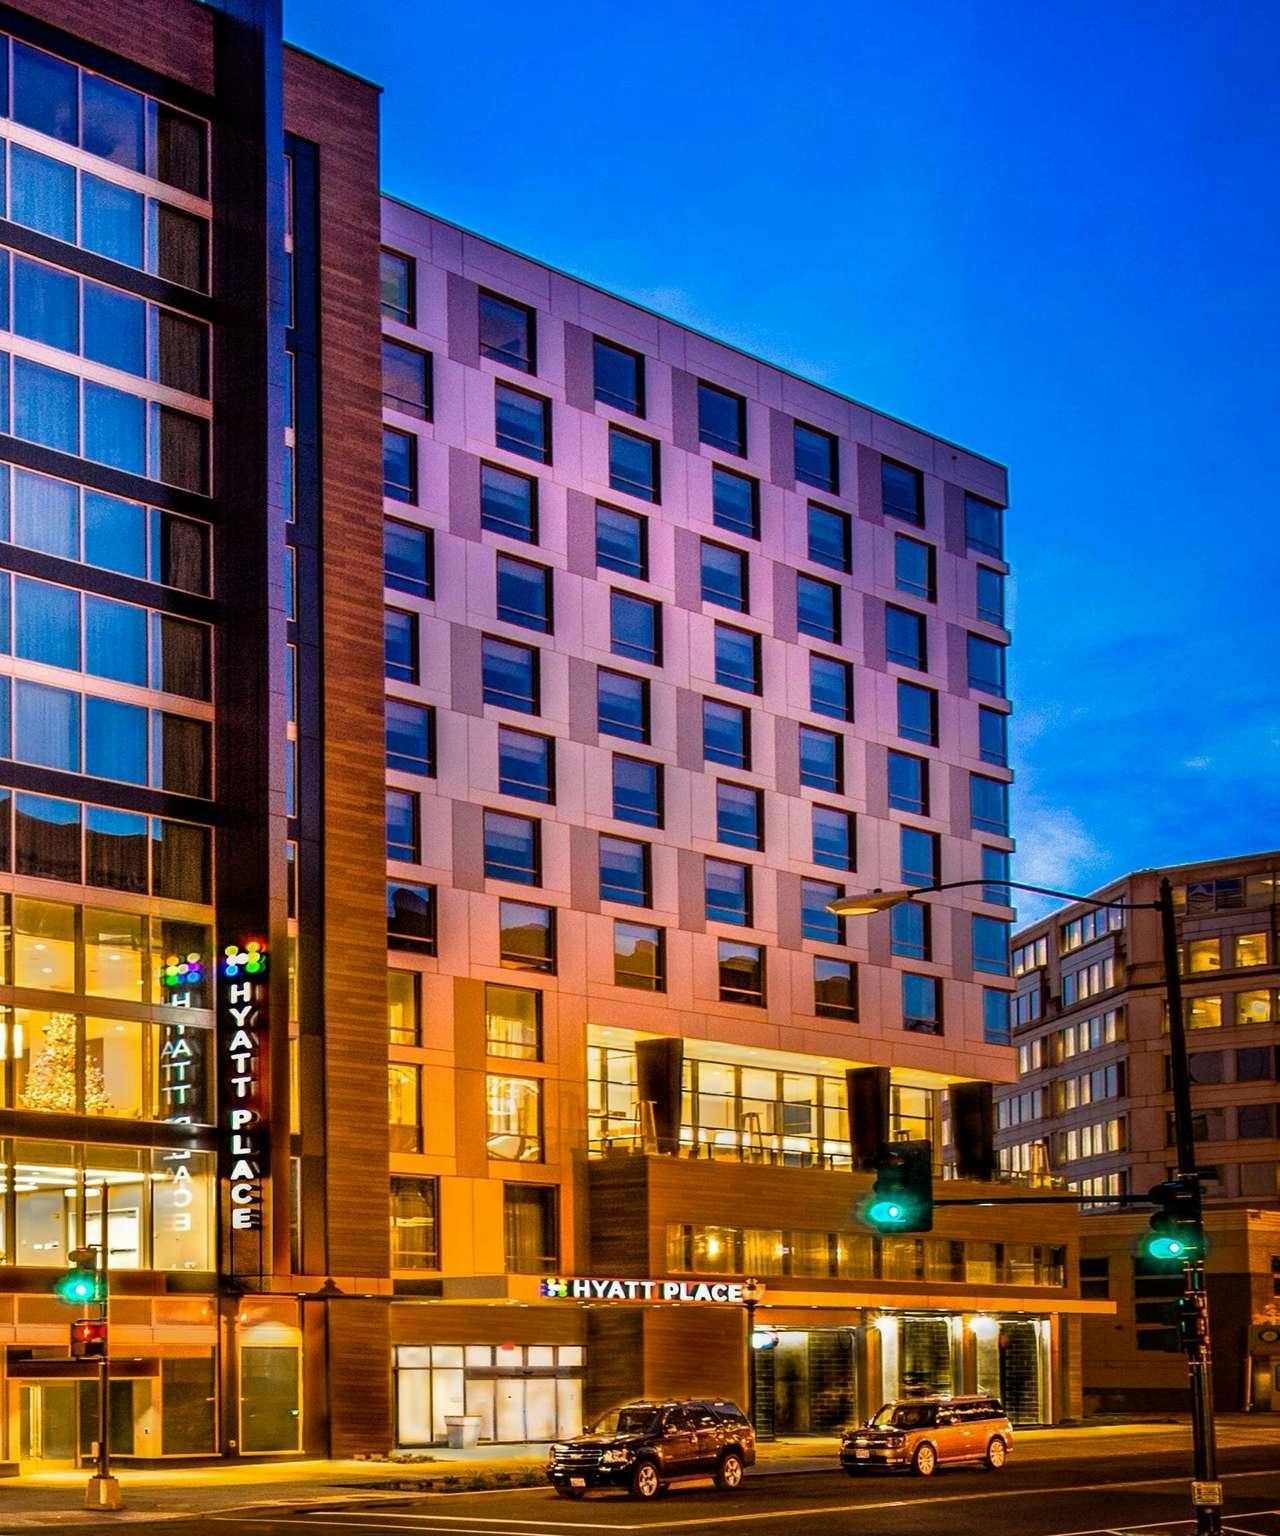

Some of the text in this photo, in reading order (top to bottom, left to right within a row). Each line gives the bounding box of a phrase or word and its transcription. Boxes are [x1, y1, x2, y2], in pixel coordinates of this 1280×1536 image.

[230, 981, 254, 1230] HYATT PLACE
[573, 1279, 743, 1302] HYATT PLACE
